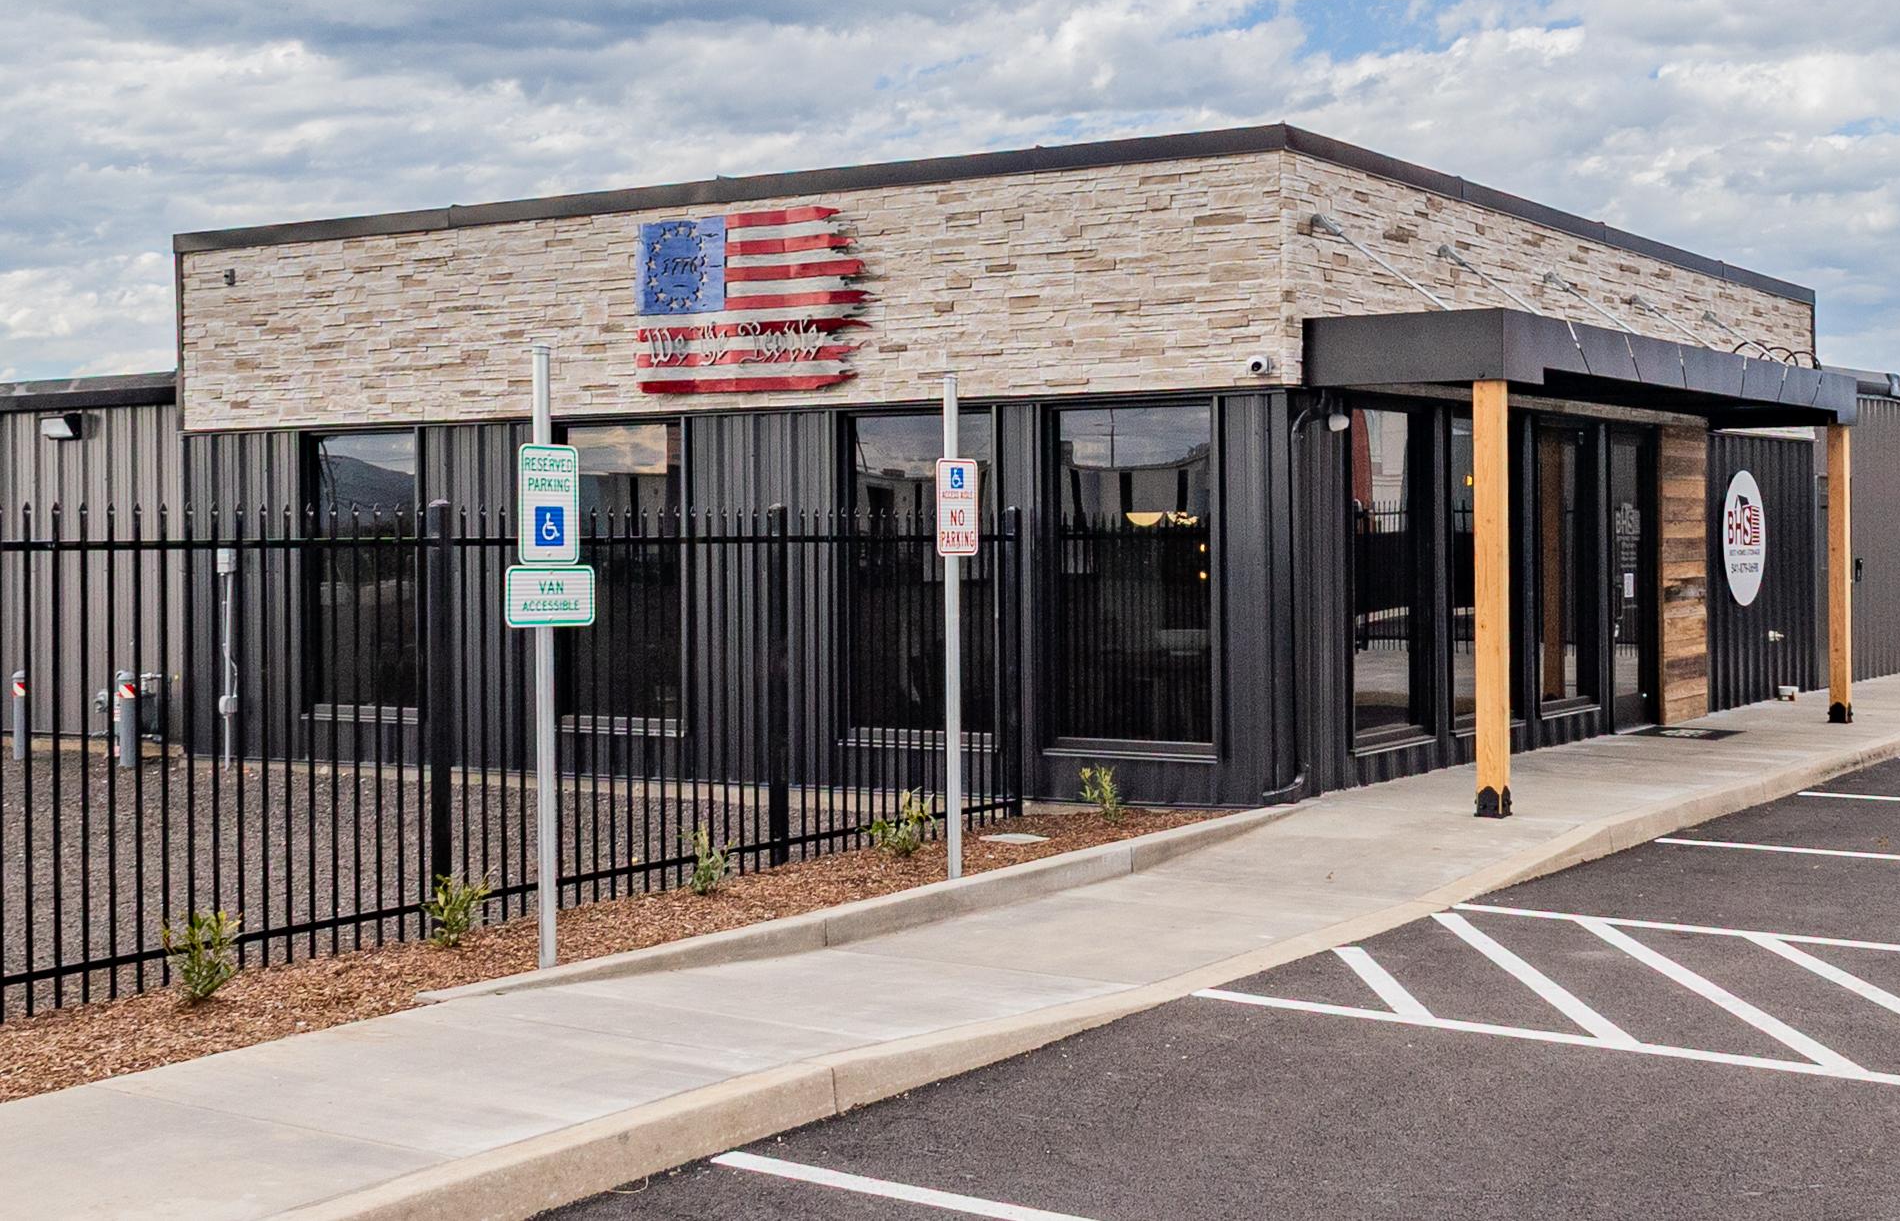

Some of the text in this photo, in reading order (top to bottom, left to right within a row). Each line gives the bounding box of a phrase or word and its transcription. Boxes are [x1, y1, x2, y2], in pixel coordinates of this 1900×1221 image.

[661, 256, 698, 276] 1776
[524, 456, 573, 474] RESERVED
[527, 476, 571, 493] PARKING
[950, 508, 965, 526] NO
[1727, 502, 1752, 546] BHS
[941, 530, 976, 548] PARKING
[538, 580, 565, 595] VAN
[521, 599, 580, 612] ACCESSIBLE
